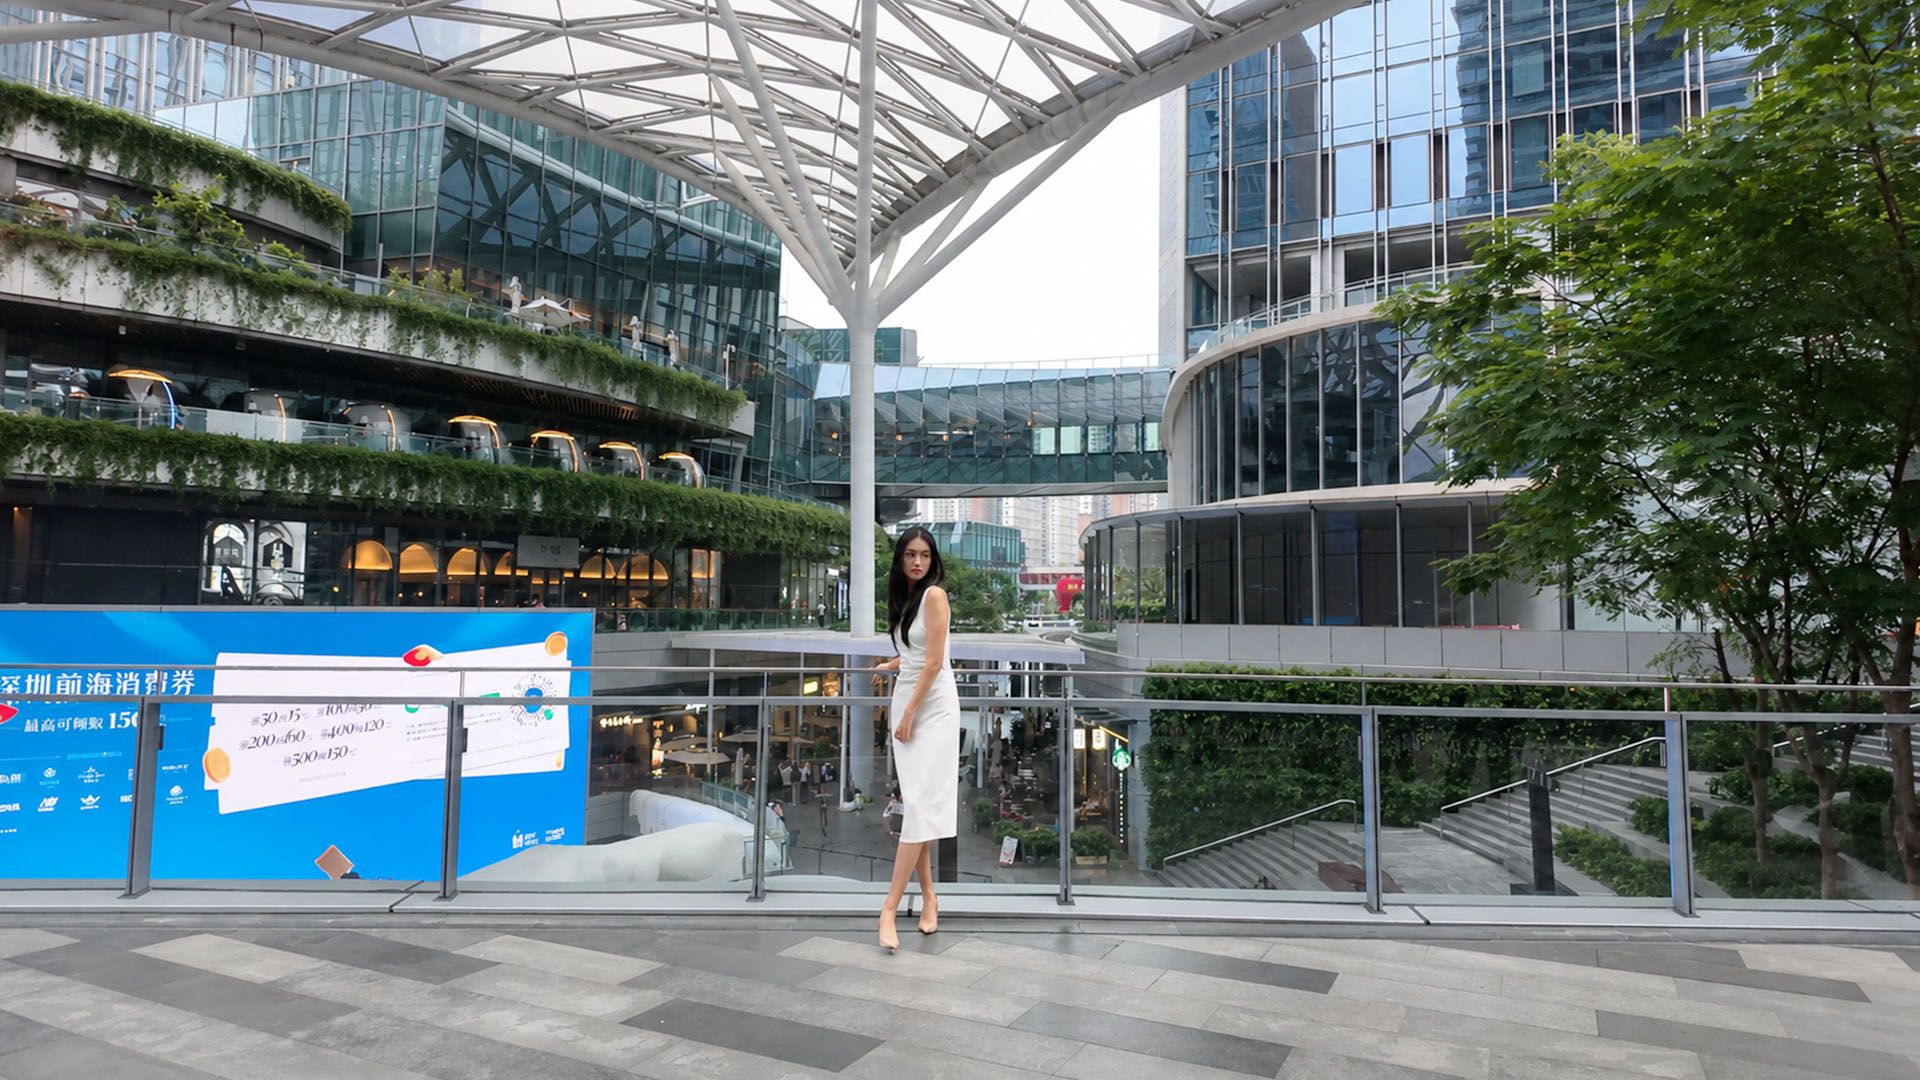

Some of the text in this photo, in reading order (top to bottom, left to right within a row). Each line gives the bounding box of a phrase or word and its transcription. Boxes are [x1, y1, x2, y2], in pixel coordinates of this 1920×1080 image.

[239, 728, 312, 750] 20060
[320, 718, 393, 740] 400120
[283, 745, 358, 768] 500150
